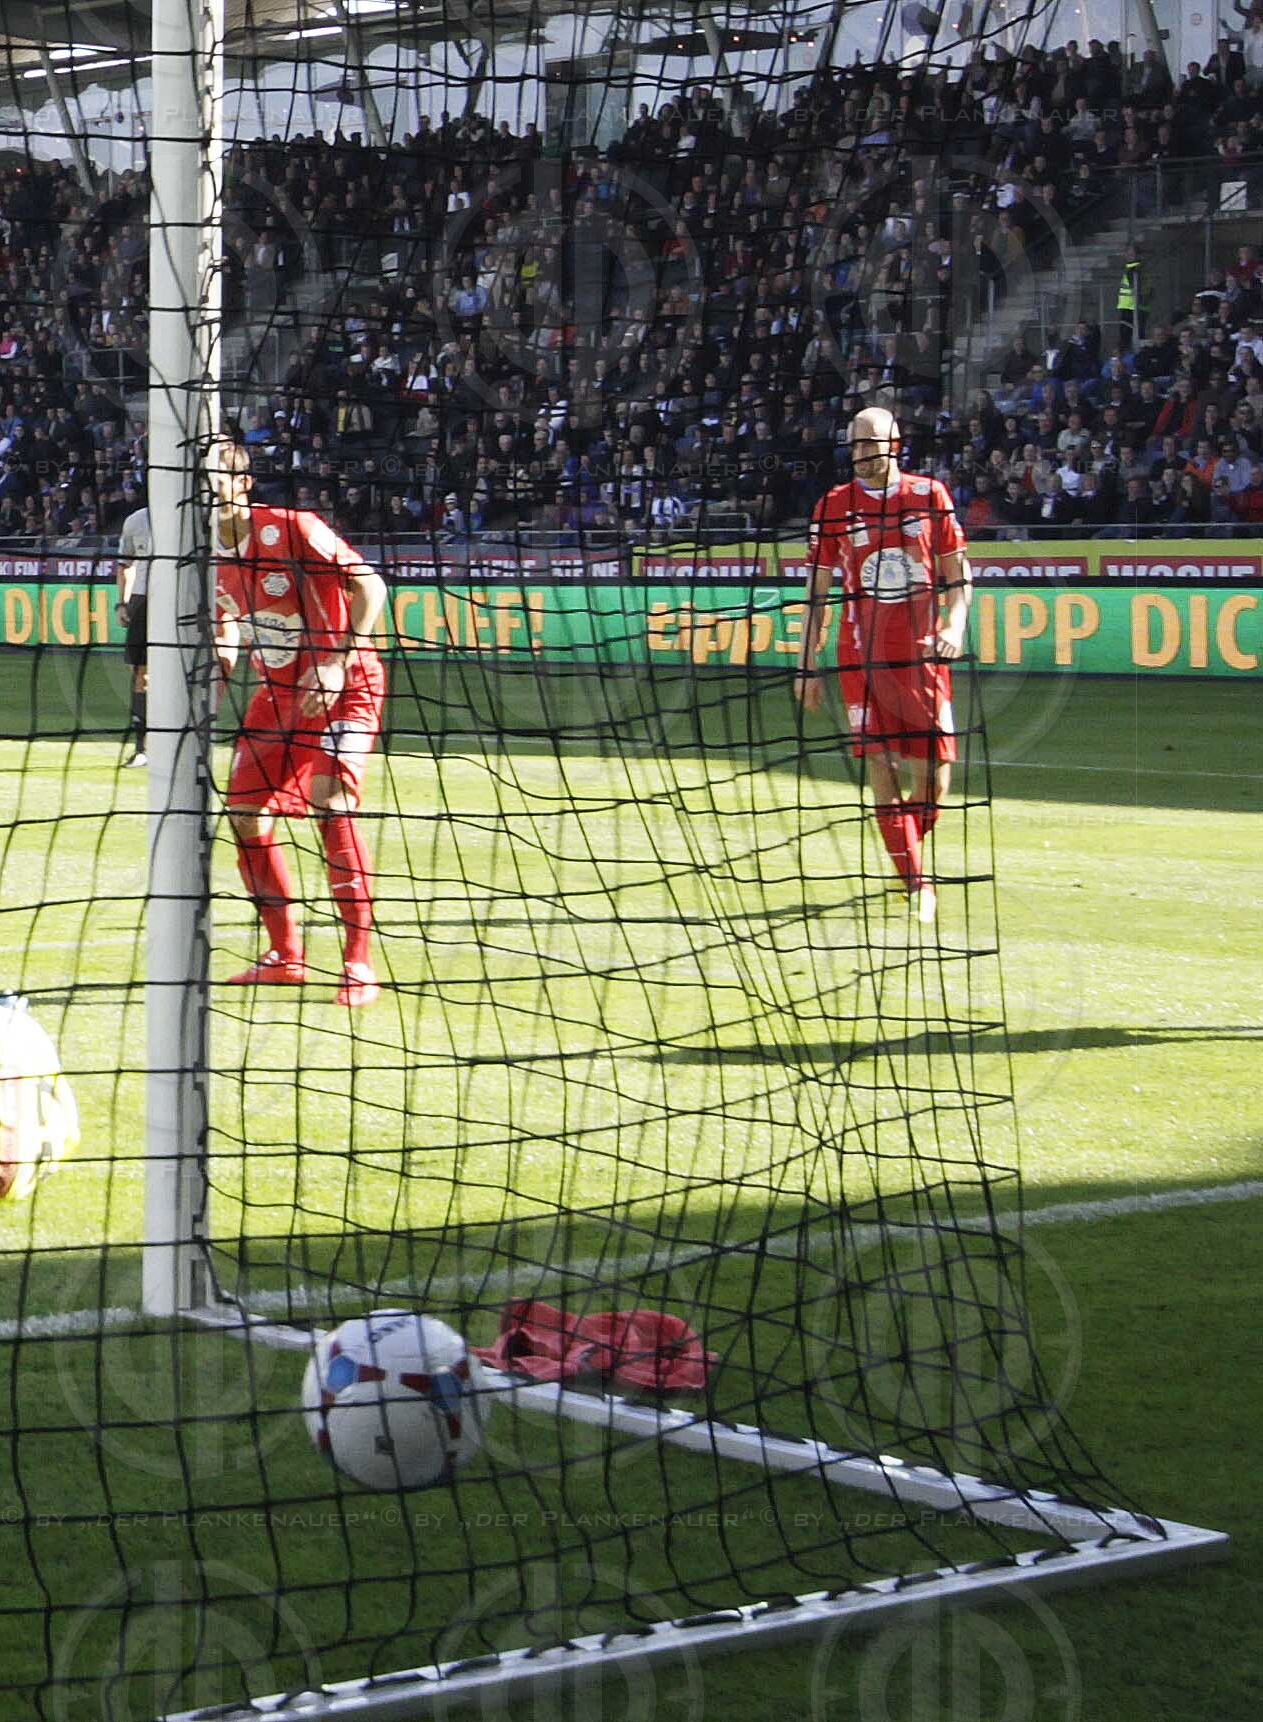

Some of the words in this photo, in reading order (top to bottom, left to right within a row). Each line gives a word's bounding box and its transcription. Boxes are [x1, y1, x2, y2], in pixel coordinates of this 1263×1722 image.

[4, 588, 109, 645] DICH
[374, 591, 545, 656] CHEF!
[647, 601, 833, 665] tipp3
[977, 593, 1100, 665] IPP
[1131, 594, 1259, 670] DIC
